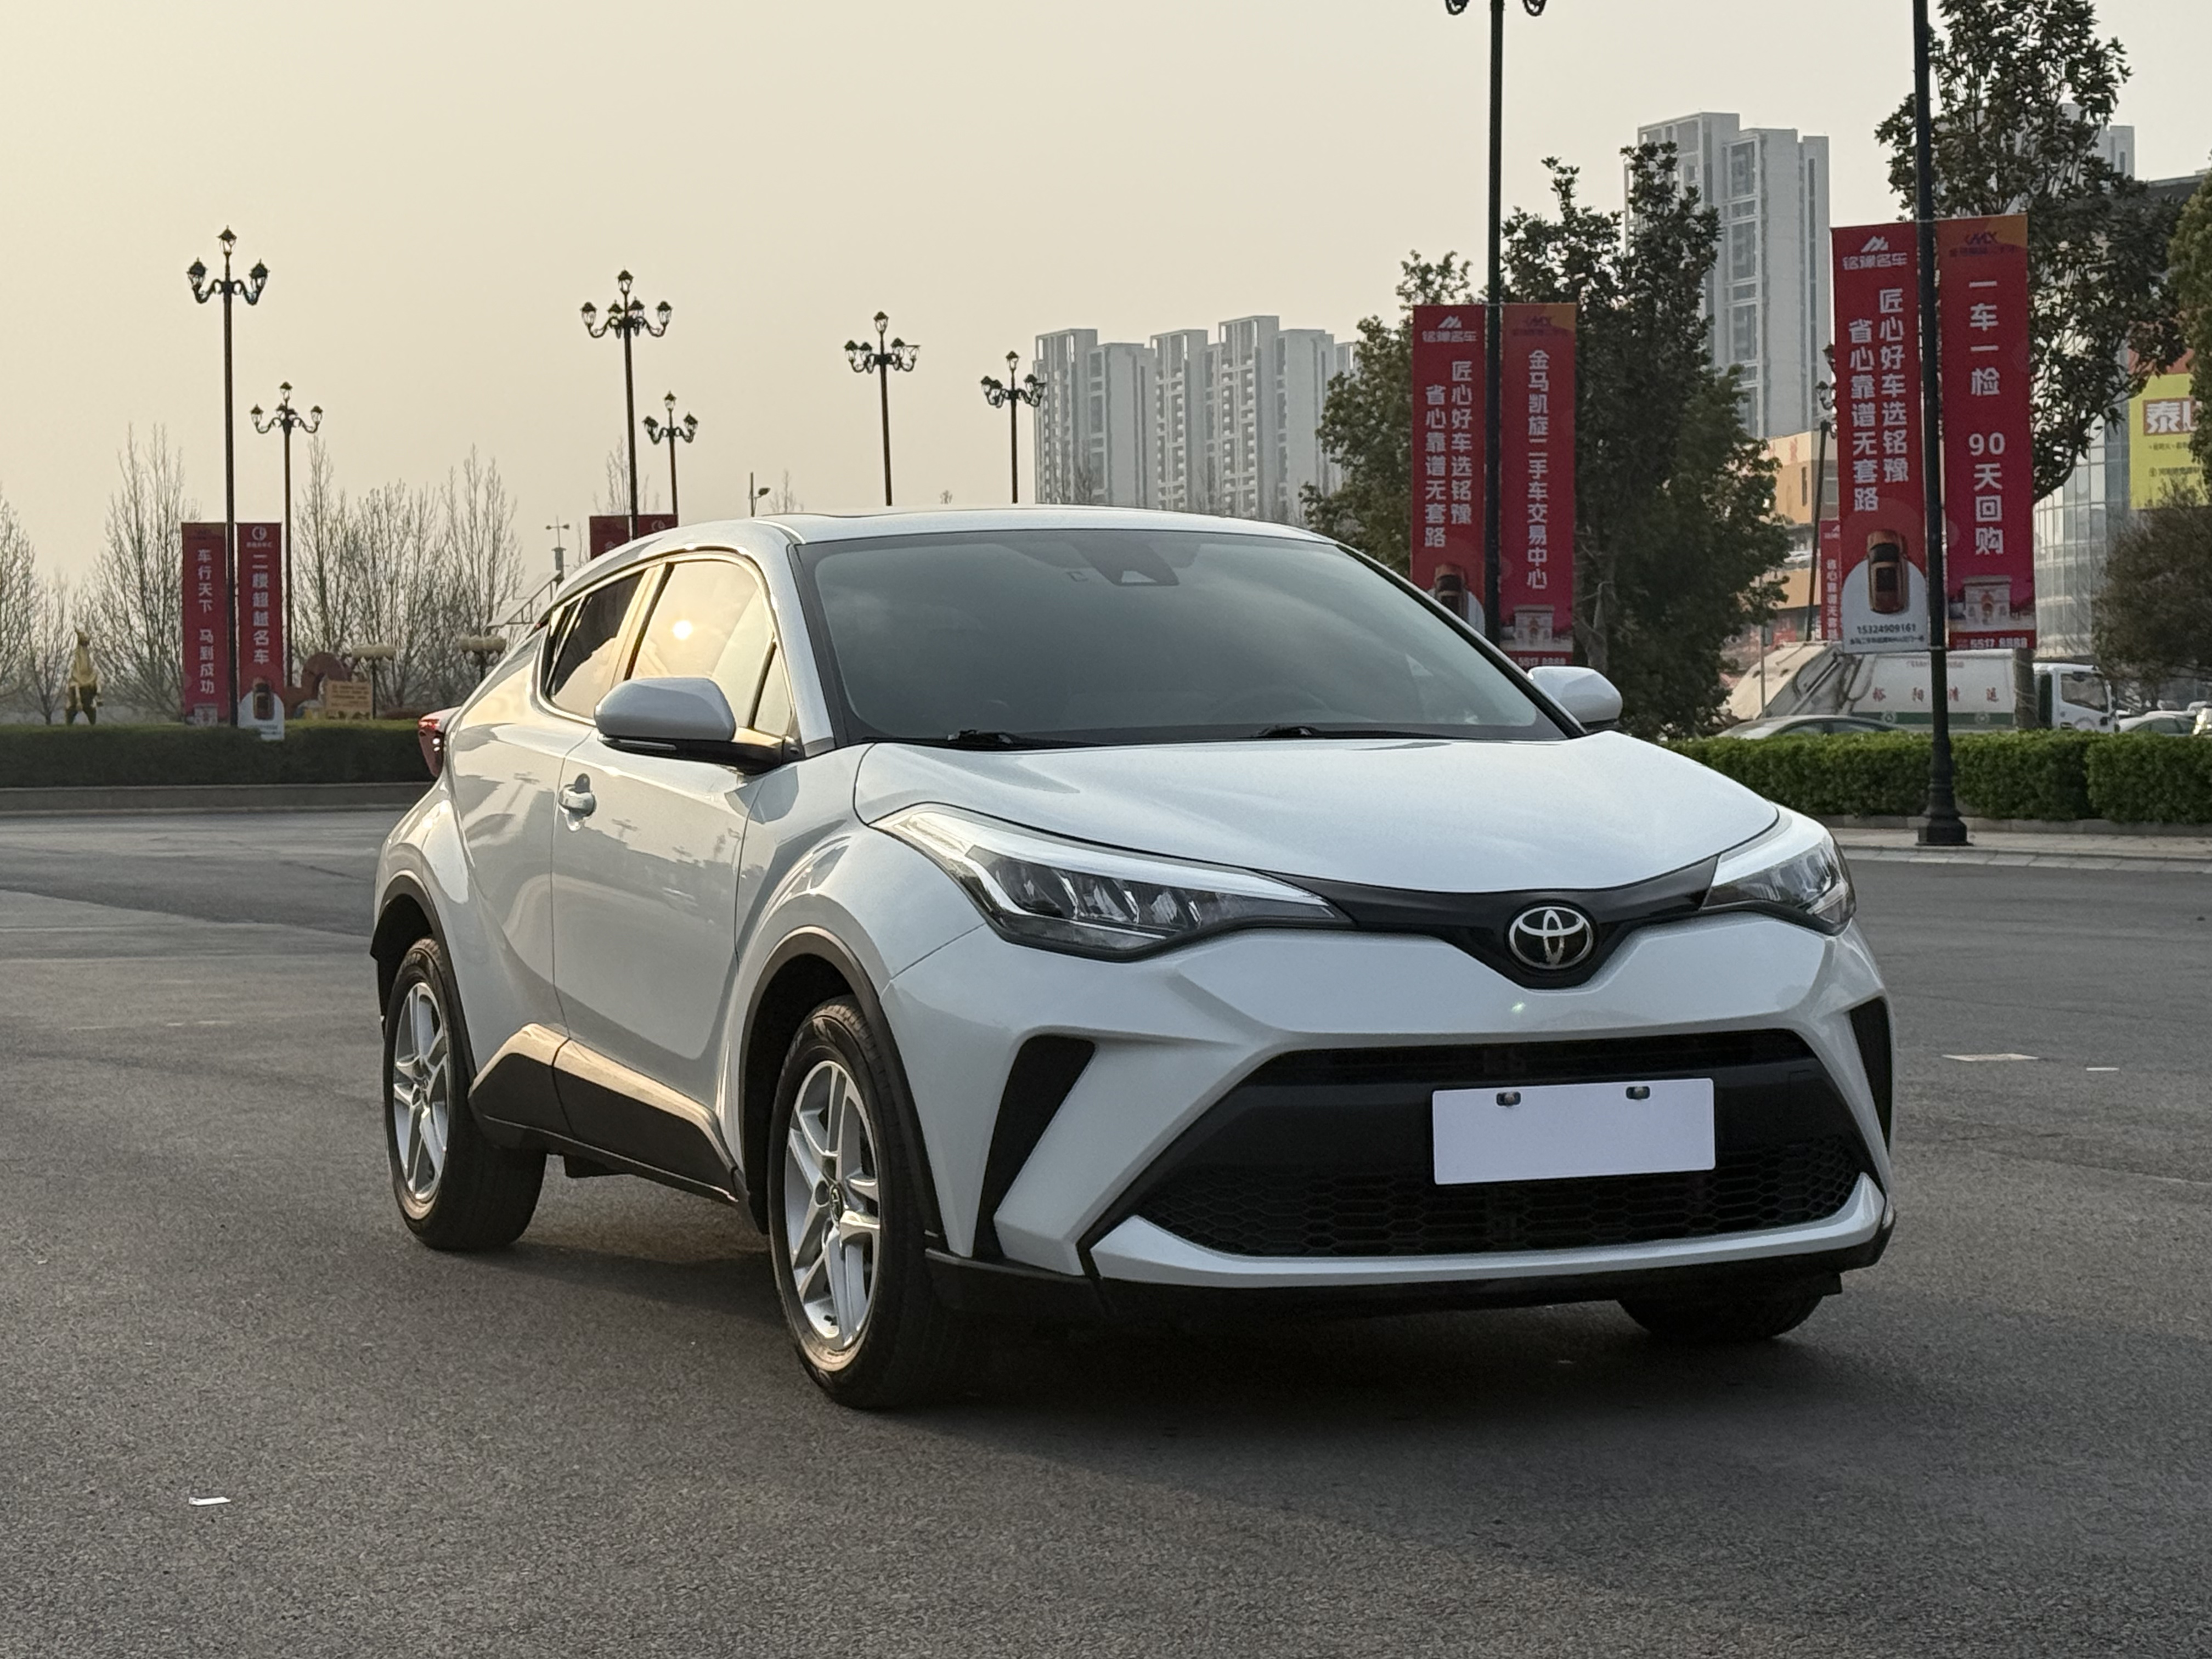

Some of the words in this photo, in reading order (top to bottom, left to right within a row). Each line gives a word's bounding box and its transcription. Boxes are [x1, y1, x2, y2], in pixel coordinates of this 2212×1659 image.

[1879, 288, 1909, 483] 匠心好车选铭豫
[1968, 280, 2001, 396] 一车一检
[1425, 384, 1447, 548] 省心靠谱无套路
[1451, 360, 1472, 524] 匠心好车选铭豫
[1527, 349, 1549, 590] 金马凯旋二手车交易中心
[1848, 319, 1879, 512] 省心靠谱无套路
[1968, 432, 2006, 555] 90天回购
[198, 549, 213, 613] 车行天下
[252, 554, 270, 665] 二楼超越名车
[199, 629, 215, 695] 马到成功
